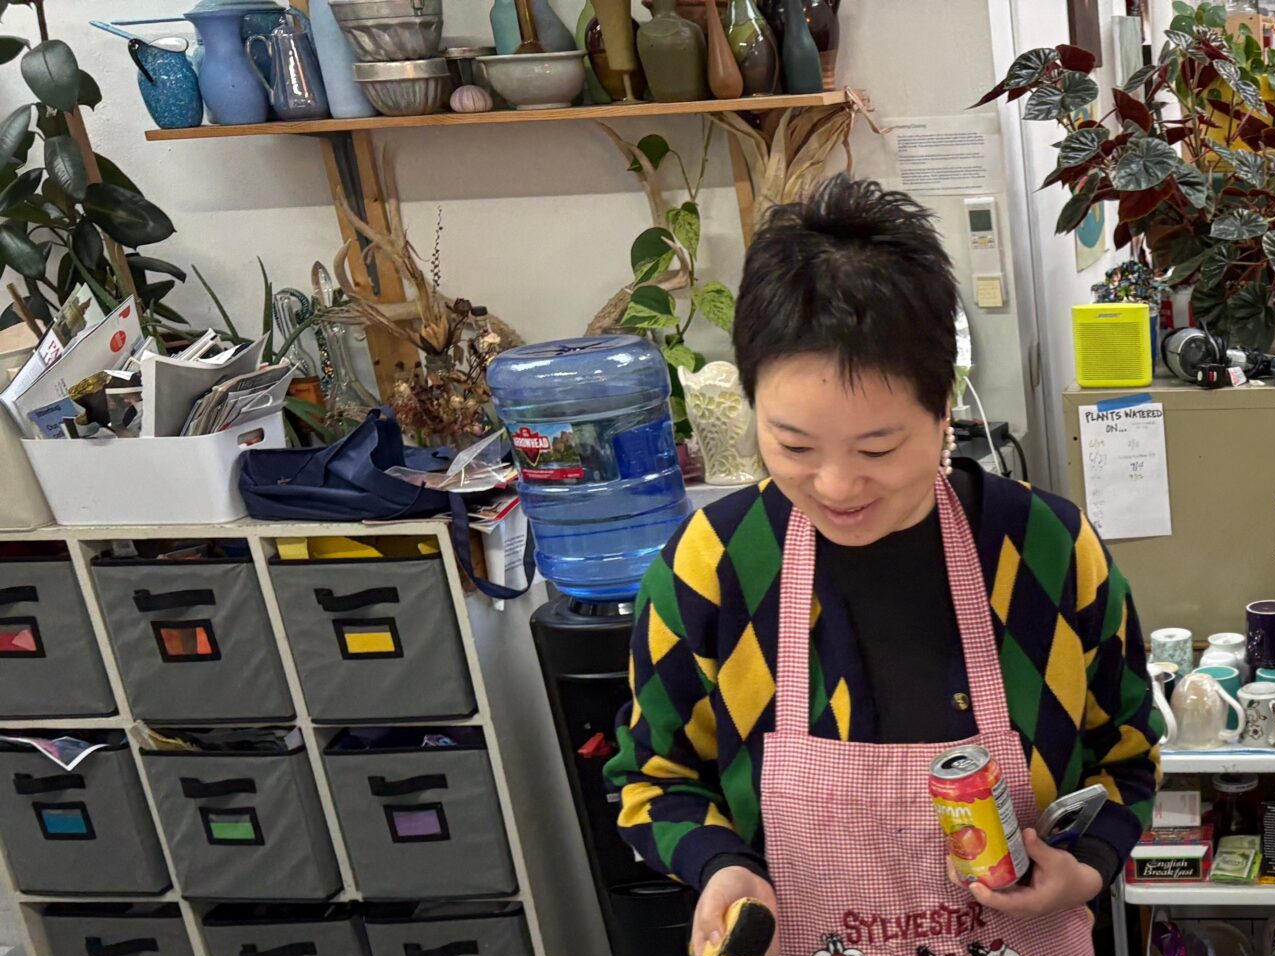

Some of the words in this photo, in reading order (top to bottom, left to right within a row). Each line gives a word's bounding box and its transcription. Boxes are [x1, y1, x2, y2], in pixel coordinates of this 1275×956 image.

[1085, 410, 1122, 423] PLANTS
[1124, 408, 1163, 419] WATERED
[1146, 859, 1188, 870] English
[1143, 867, 1194, 878] Breakfast
[843, 901, 986, 944] SYLVESTER
